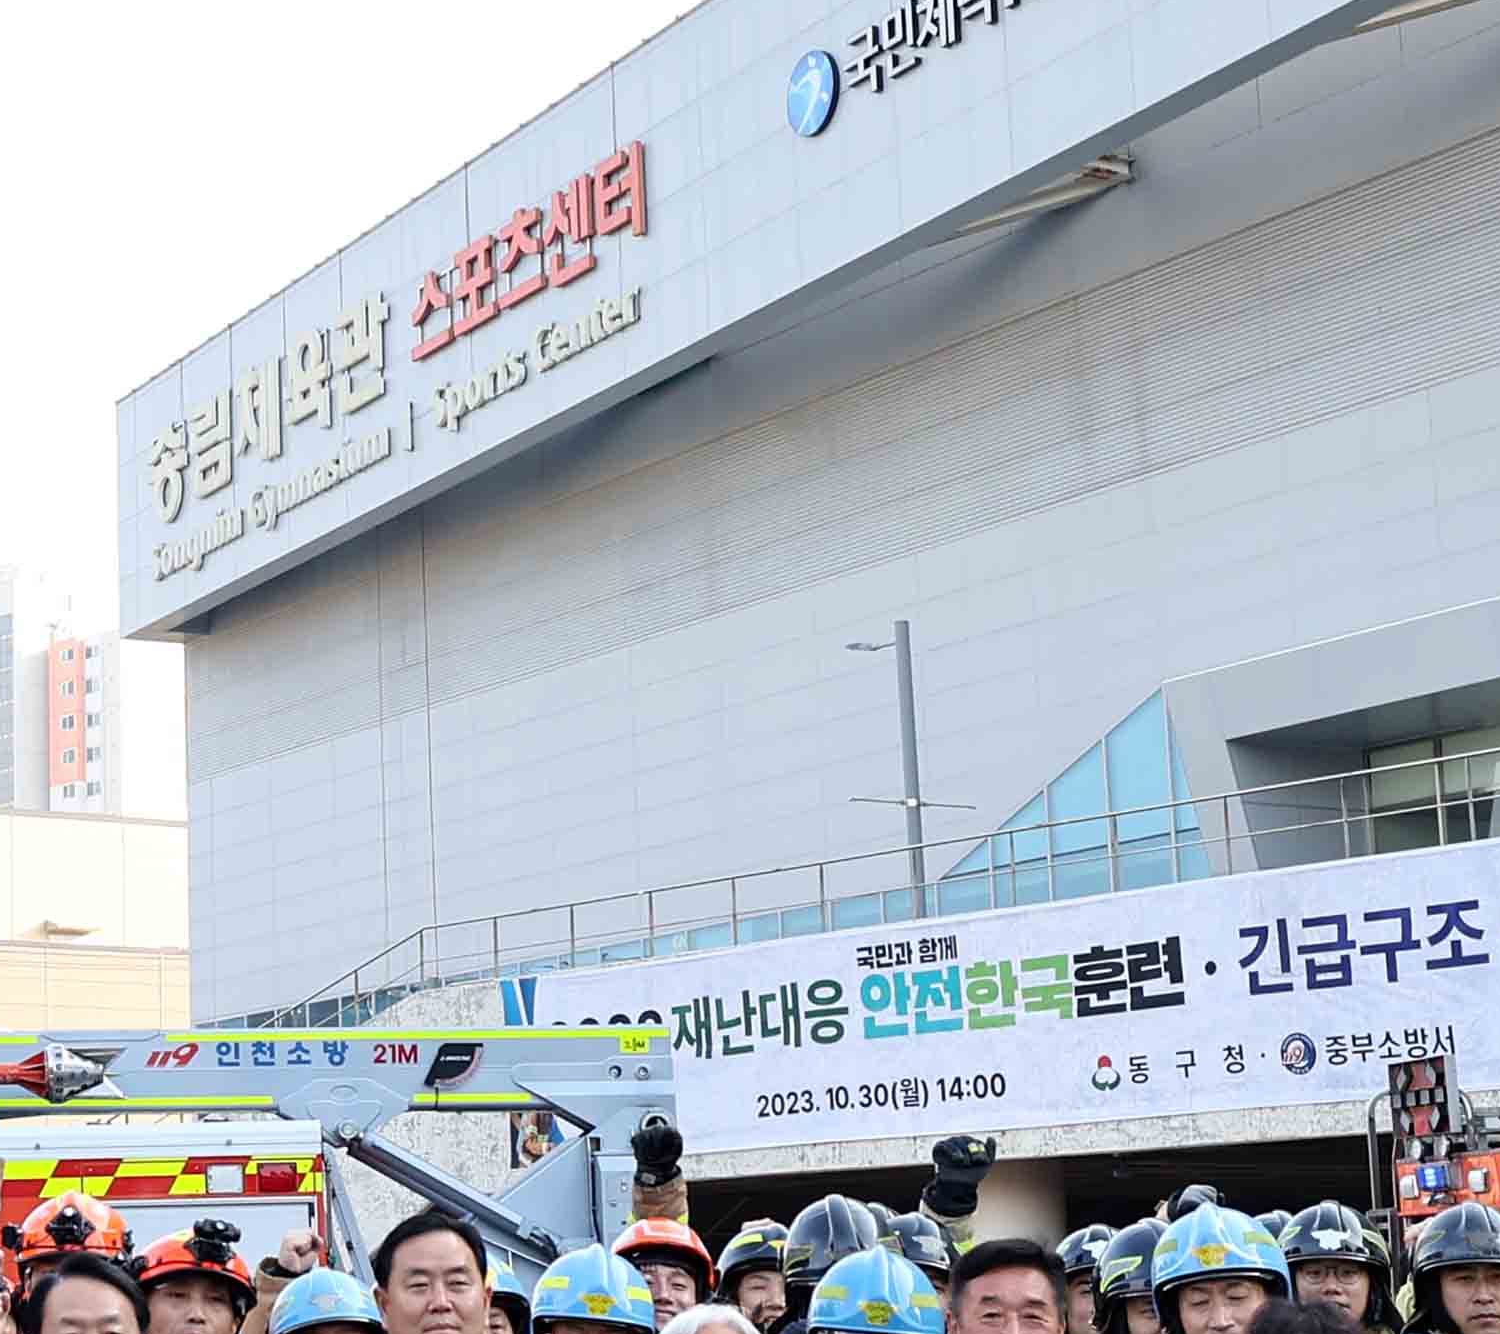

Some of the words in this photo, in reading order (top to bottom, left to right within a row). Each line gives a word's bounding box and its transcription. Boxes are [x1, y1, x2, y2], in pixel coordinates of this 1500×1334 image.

[150, 290, 391, 524] 송림체육관
[411, 139, 648, 362] 스포츠센터
[153, 508, 244, 581] Songnim
[250, 427, 392, 531] Gymnasium
[433, 351, 528, 433] Sports
[536, 285, 641, 373] Center
[856, 940, 914, 970] 국민과
[918, 935, 959, 963] 함께
[671, 977, 850, 1060] 재난대응
[860, 935, 1185, 1040] 안전한국훈련
[1237, 895, 1490, 997] 긴급구조
[146, 1042, 200, 1067] 119
[373, 1043, 419, 1065] 21M
[1325, 1025, 1456, 1066] 중부소방서
[936, 1072, 1007, 1102] 14:00
